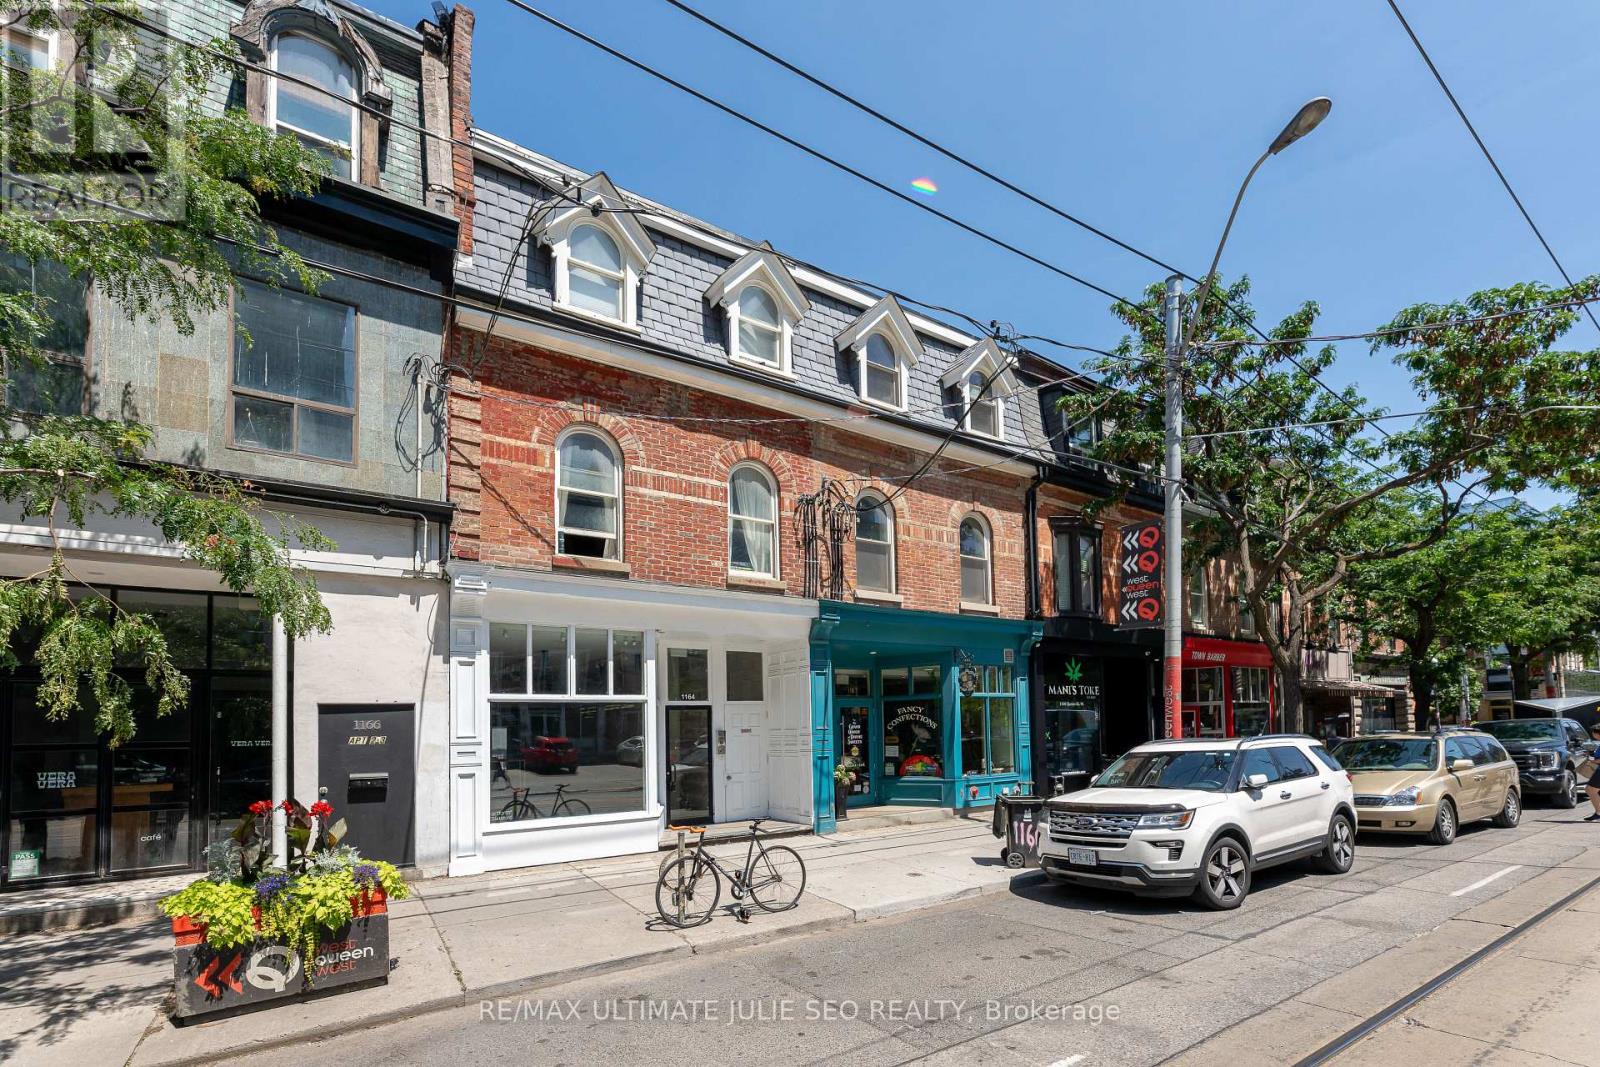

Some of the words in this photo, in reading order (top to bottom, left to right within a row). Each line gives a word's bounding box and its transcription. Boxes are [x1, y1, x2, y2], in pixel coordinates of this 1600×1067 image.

[1126, 576, 1149, 585] west
[1126, 590, 1149, 600] west
[1191, 651, 1207, 660] TOWN
[1078, 685, 1100, 696] TOKE
[897, 705, 925, 715] FANCY
[353, 720, 382, 730] 1166
[887, 713, 938, 730] CONFECTIONS
[36, 771, 77, 781] VERA
[36, 779, 77, 789] VERA
[140, 832, 162, 842] café
[15, 852, 36, 861] PASS
[316, 938, 357, 953] west
[316, 960, 357, 977] west
